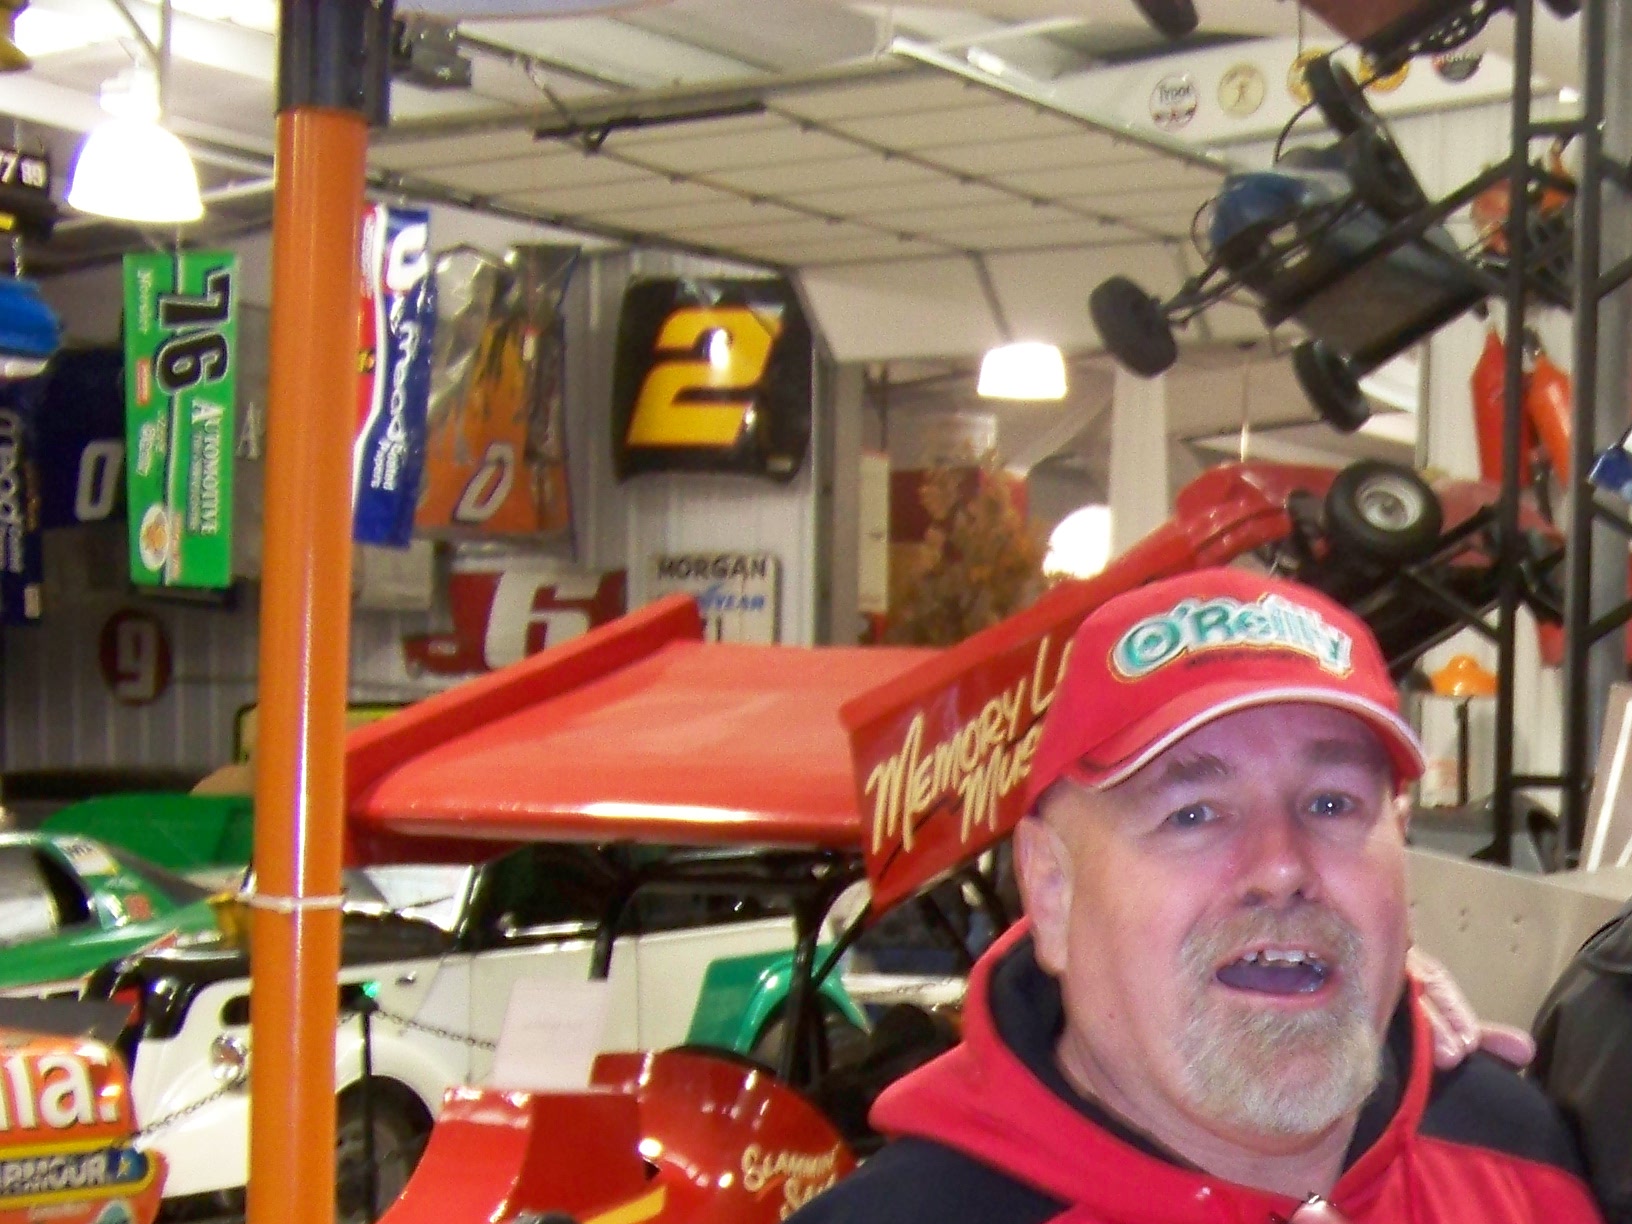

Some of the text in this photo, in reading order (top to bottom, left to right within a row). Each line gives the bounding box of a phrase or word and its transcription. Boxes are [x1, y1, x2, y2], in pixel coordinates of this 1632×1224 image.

[154, 267, 233, 394] 76
[624, 305, 782, 447] 2
[453, 441, 515, 525] 0
[657, 555, 767, 580] MORGAN
[1110, 594, 1352, 680] O'Reilly
